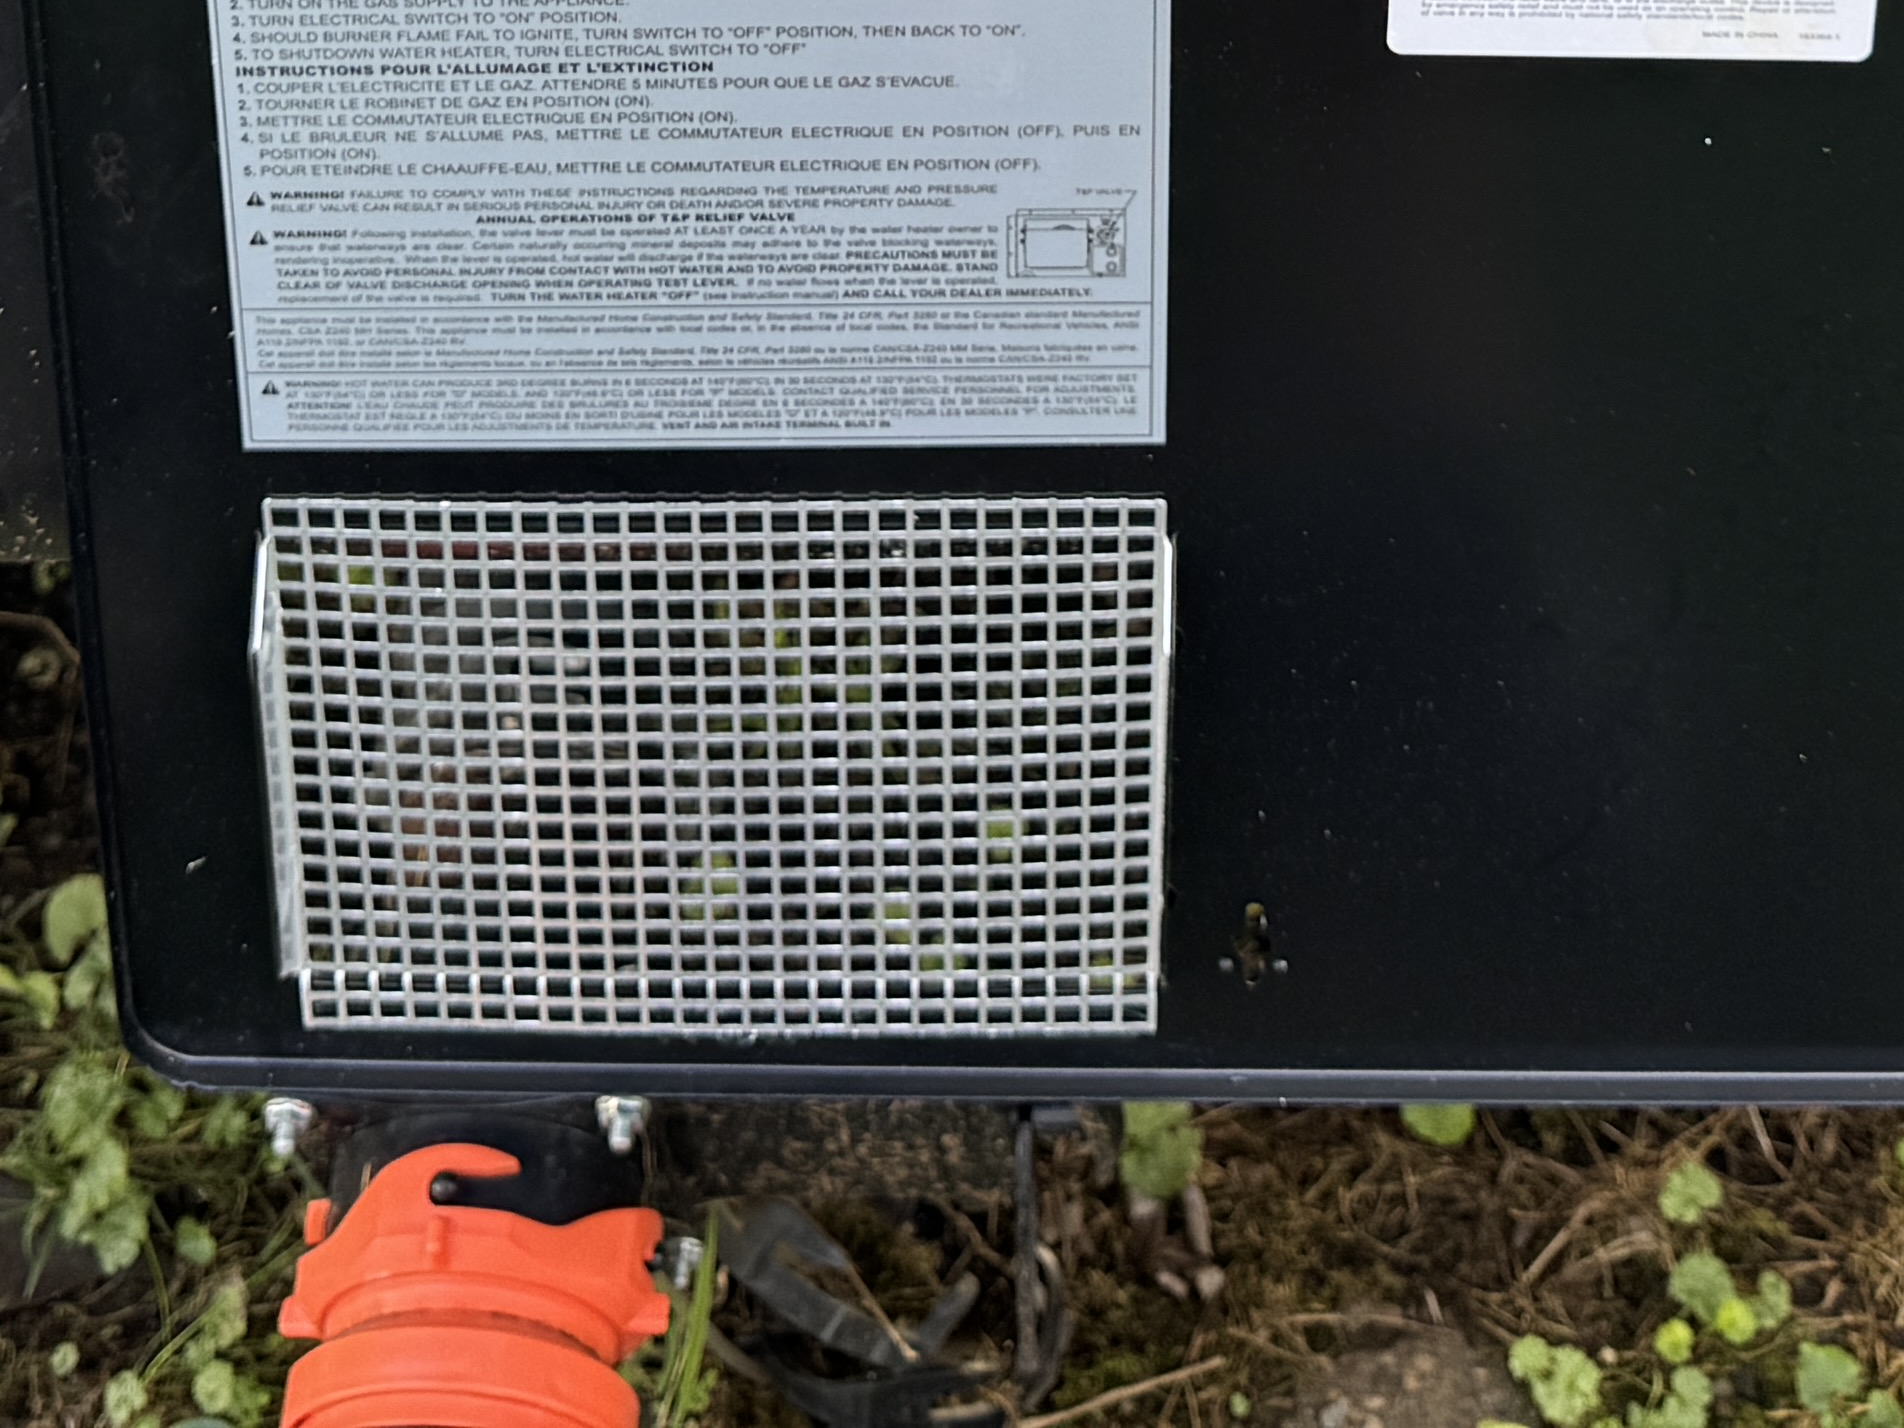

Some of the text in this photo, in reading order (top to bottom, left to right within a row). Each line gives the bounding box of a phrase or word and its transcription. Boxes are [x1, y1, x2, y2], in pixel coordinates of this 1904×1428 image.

[234, 60, 713, 78] INSTRUCTIONS POUR L'ALLUMAGE ET L'EXTINCTION
